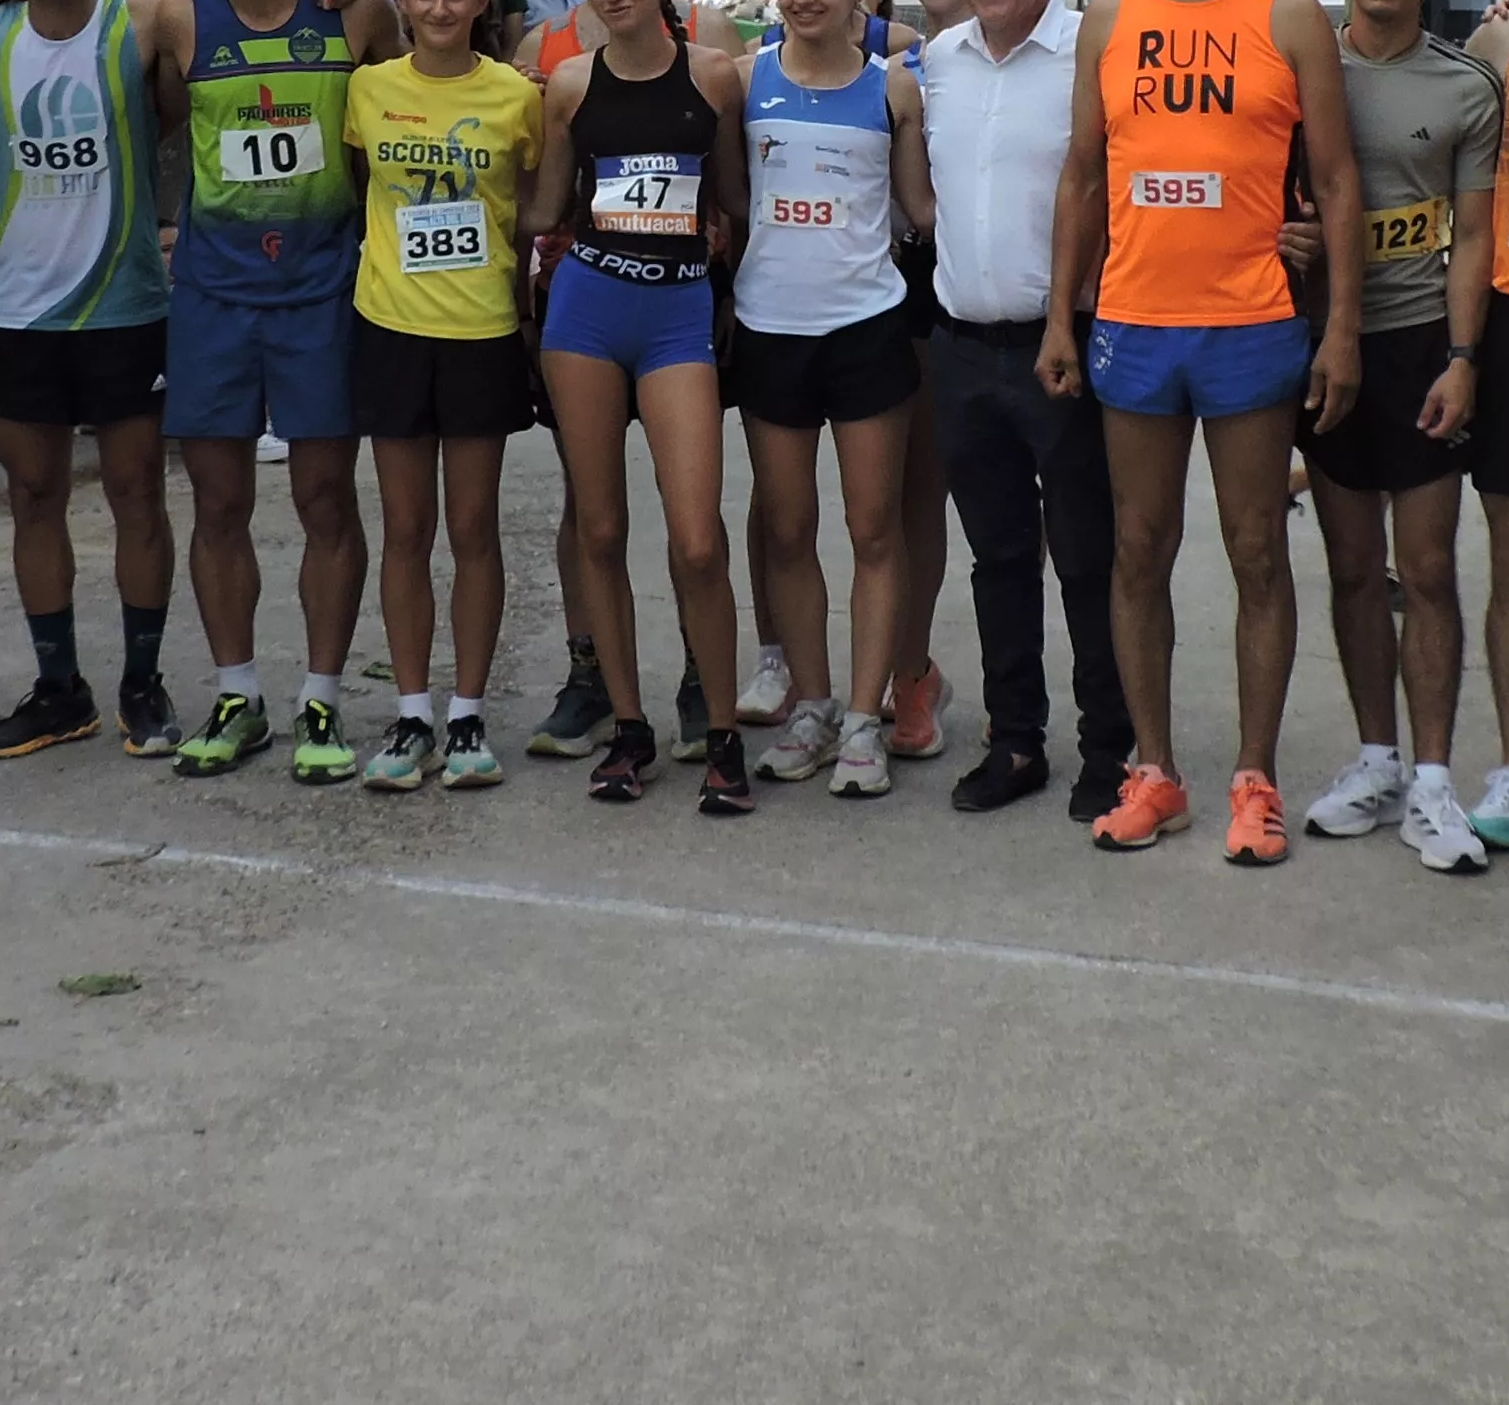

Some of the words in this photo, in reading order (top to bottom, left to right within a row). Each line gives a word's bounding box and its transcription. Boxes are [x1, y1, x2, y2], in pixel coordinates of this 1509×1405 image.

[1138, 29, 1236, 70] RUN
[1133, 73, 1235, 115] RUN
[19, 137, 98, 170] 968
[243, 132, 298, 176] 10
[377, 141, 491, 170] SCORPIO
[623, 176, 672, 209] 47
[1144, 178, 1206, 204] 595
[600, 214, 691, 233] mutuacat
[774, 198, 833, 225] 593
[407, 226, 480, 259] 383
[1371, 212, 1428, 251] 122
[600, 253, 665, 280] PRO
